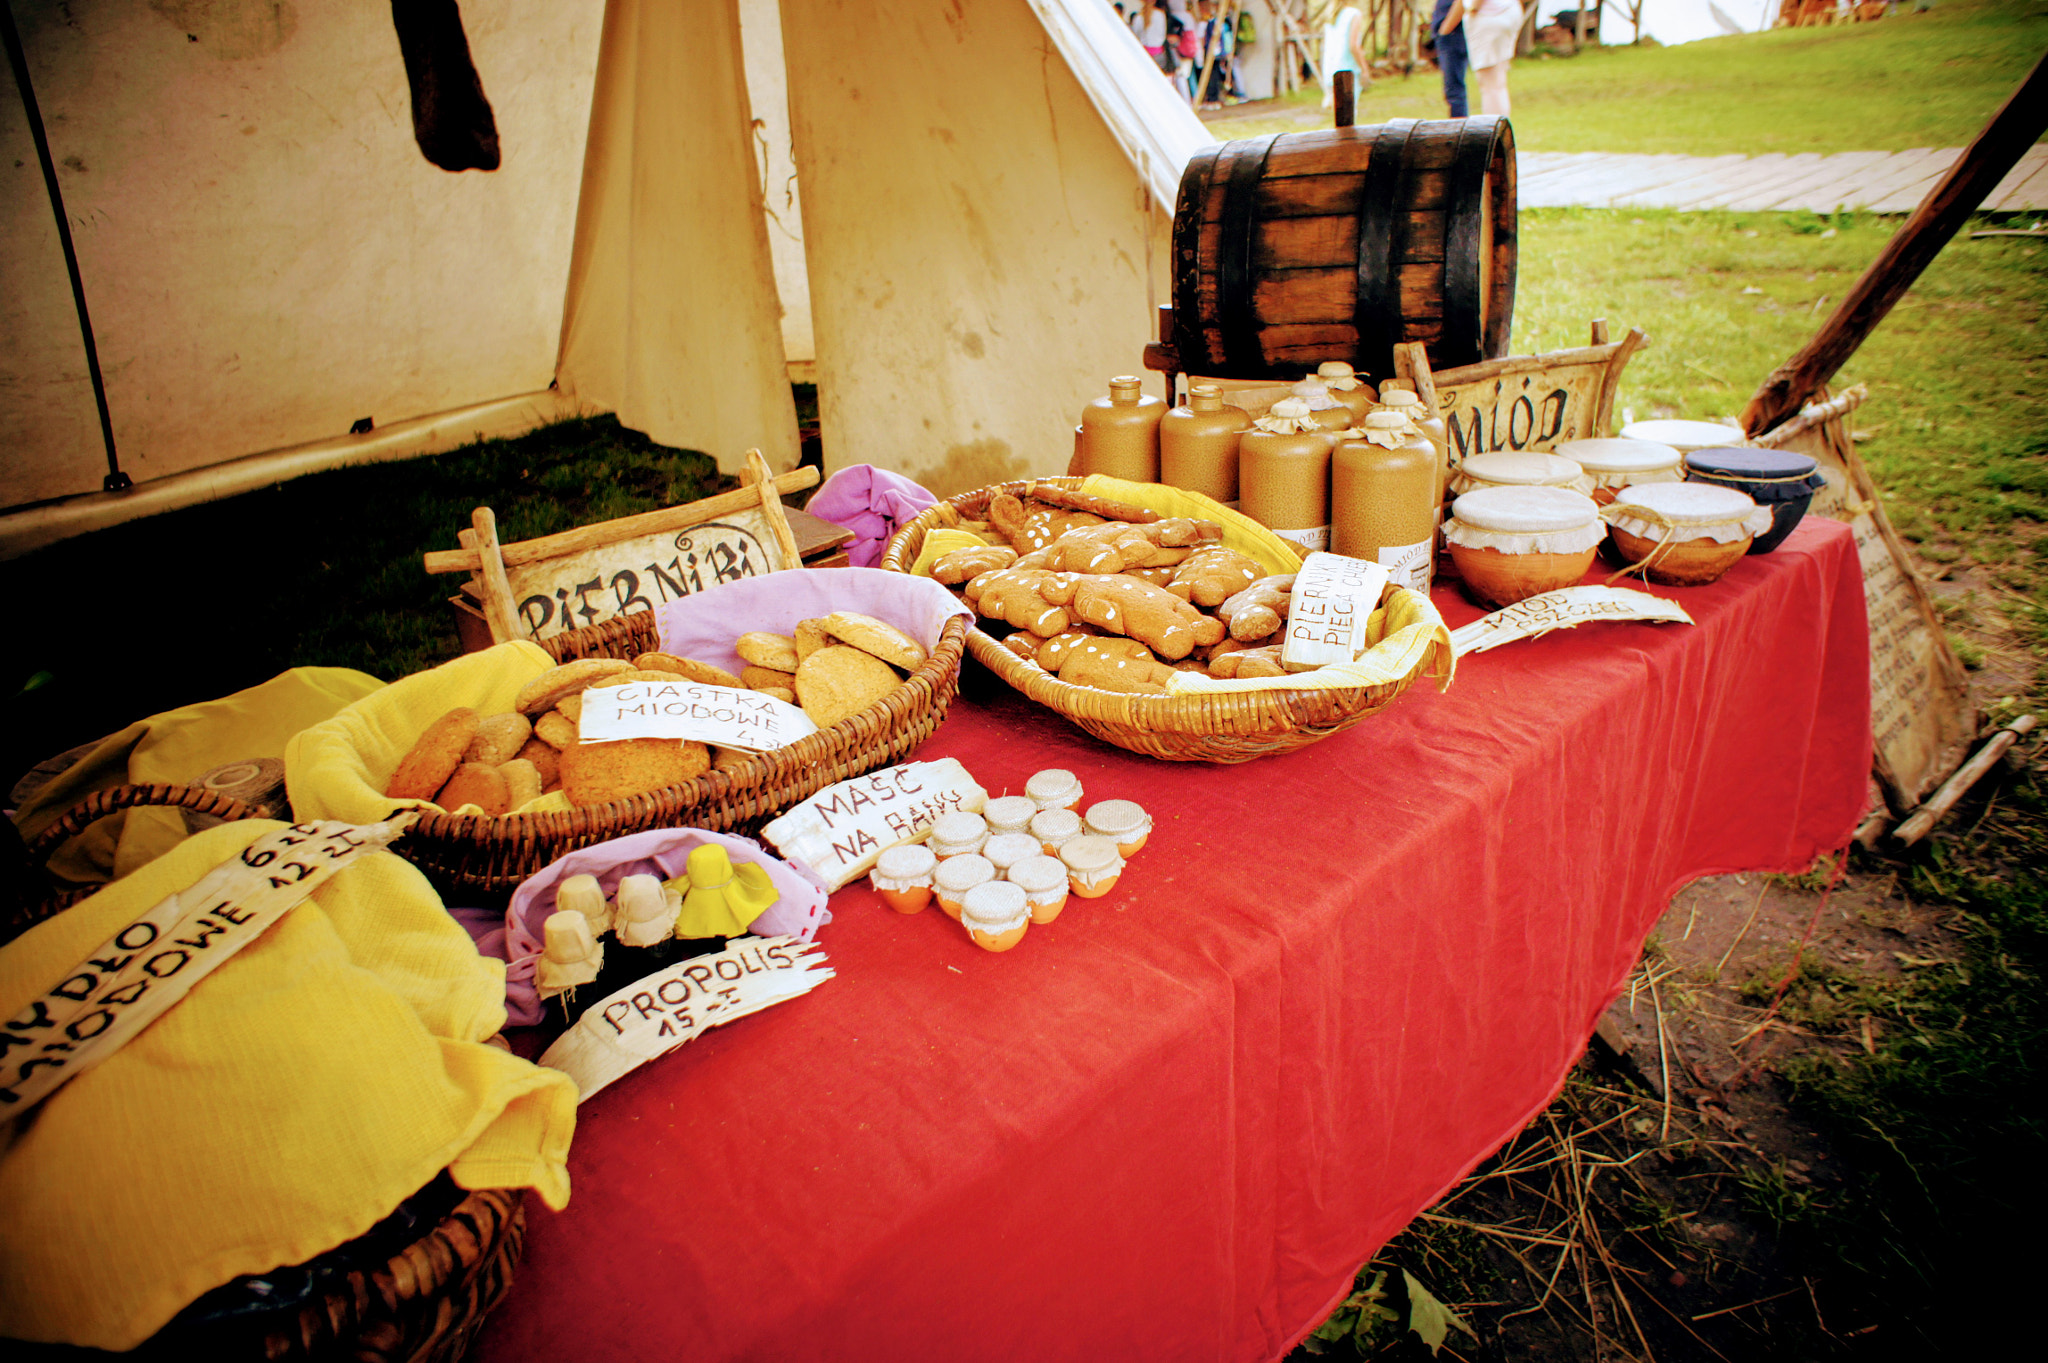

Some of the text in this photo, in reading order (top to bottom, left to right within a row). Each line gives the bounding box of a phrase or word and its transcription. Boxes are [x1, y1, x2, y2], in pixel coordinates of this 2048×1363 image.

[616, 685, 779, 717] CIASTKA
[617, 702, 779, 734] MIODOWE
[241, 845, 279, 869] 6
[832, 829, 879, 865] NA
[268, 862, 320, 890] 12
[602, 945, 795, 1036] PROPOLIS
[658, 1006, 696, 1037] 15
